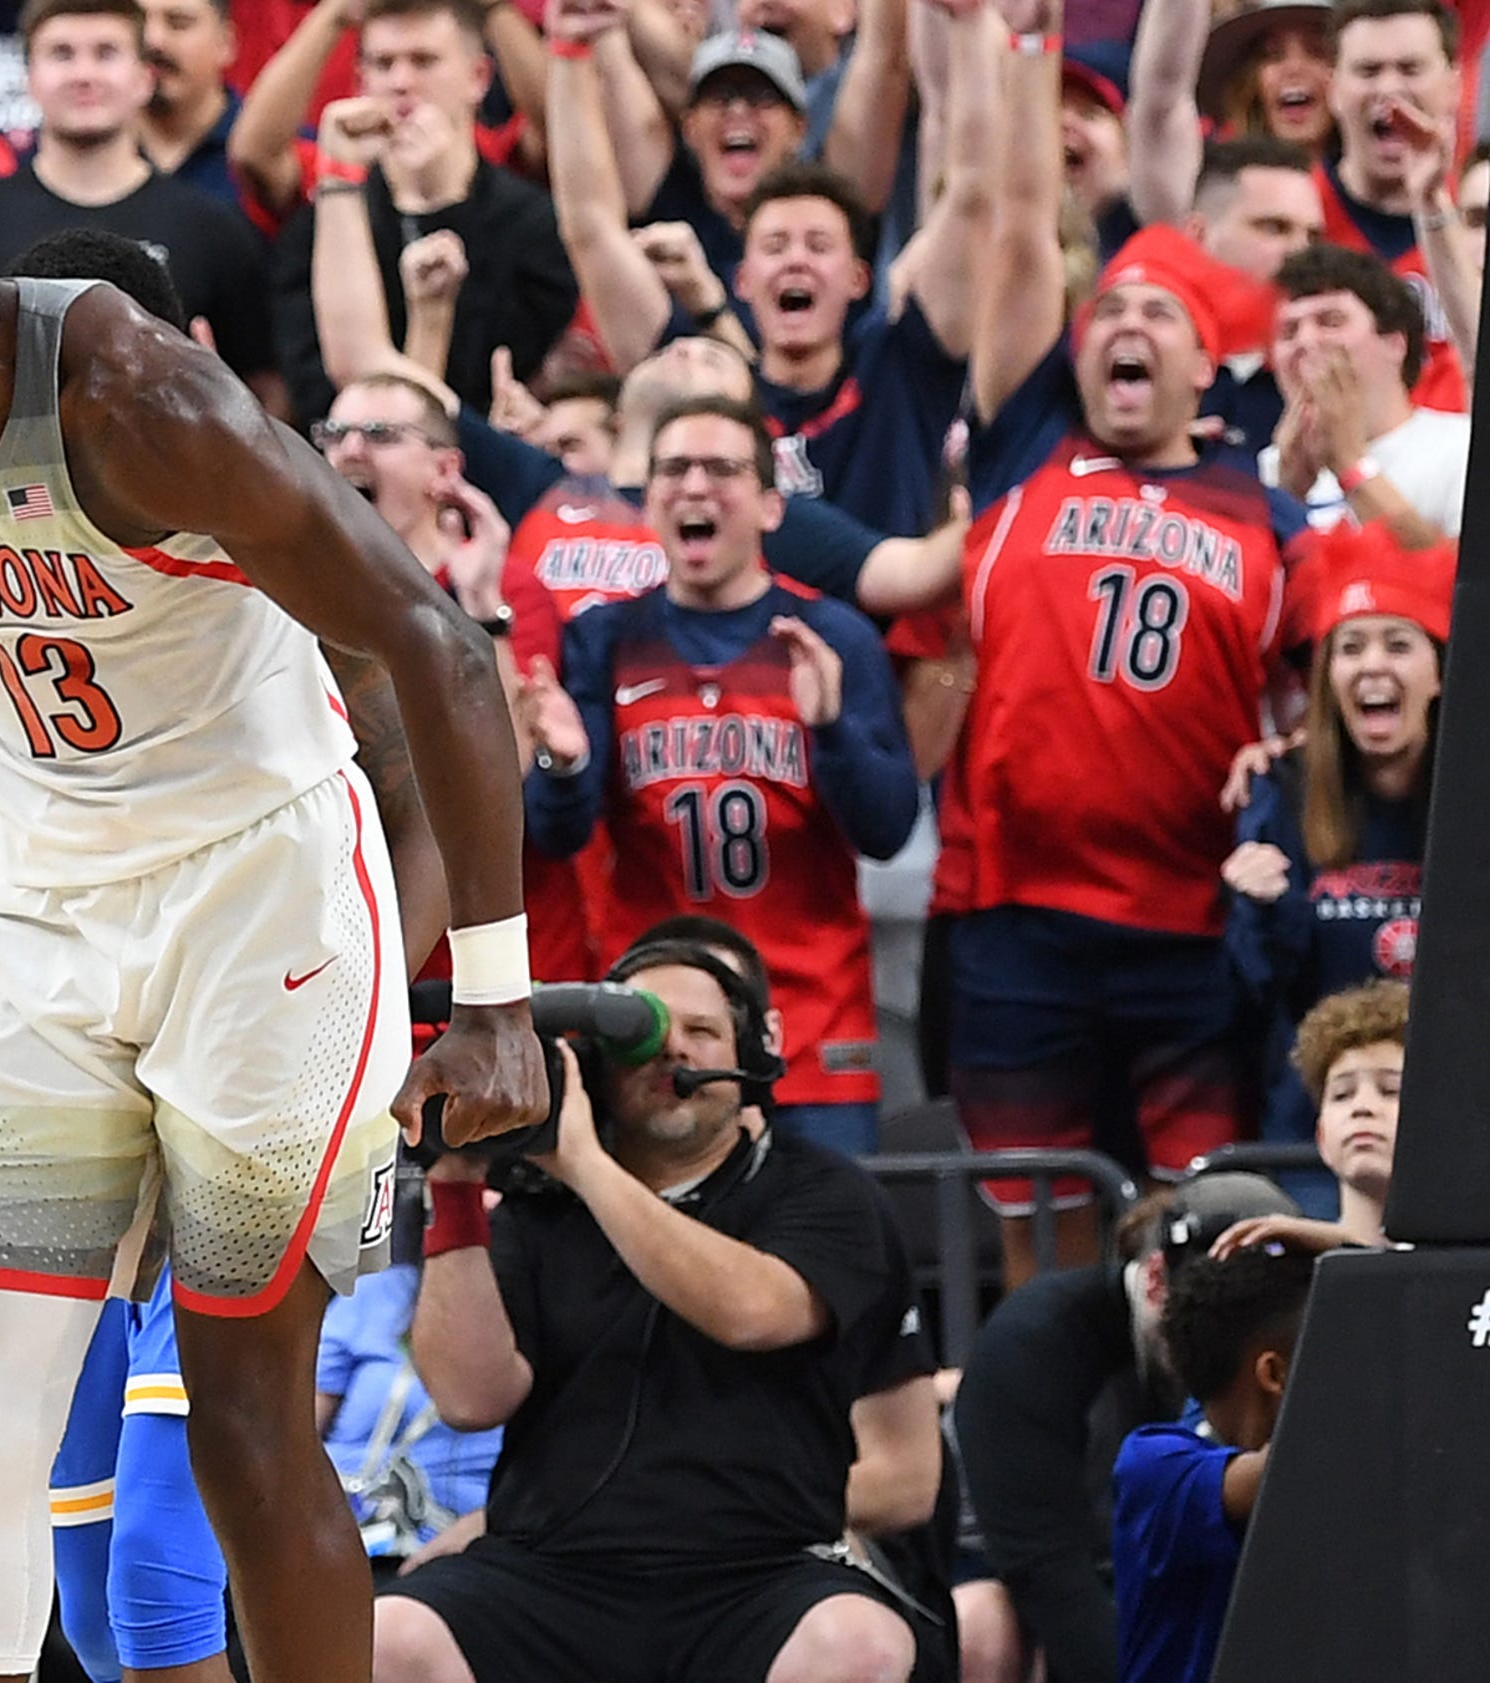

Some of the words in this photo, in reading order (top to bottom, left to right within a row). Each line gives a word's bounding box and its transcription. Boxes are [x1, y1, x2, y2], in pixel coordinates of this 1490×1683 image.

[534, 537, 670, 597] ARIZO
[1043, 497, 1244, 603] ARIZONA
[1088, 563, 1190, 692] 18
[620, 714, 808, 790] ARIZONA
[664, 779, 770, 902] 18
